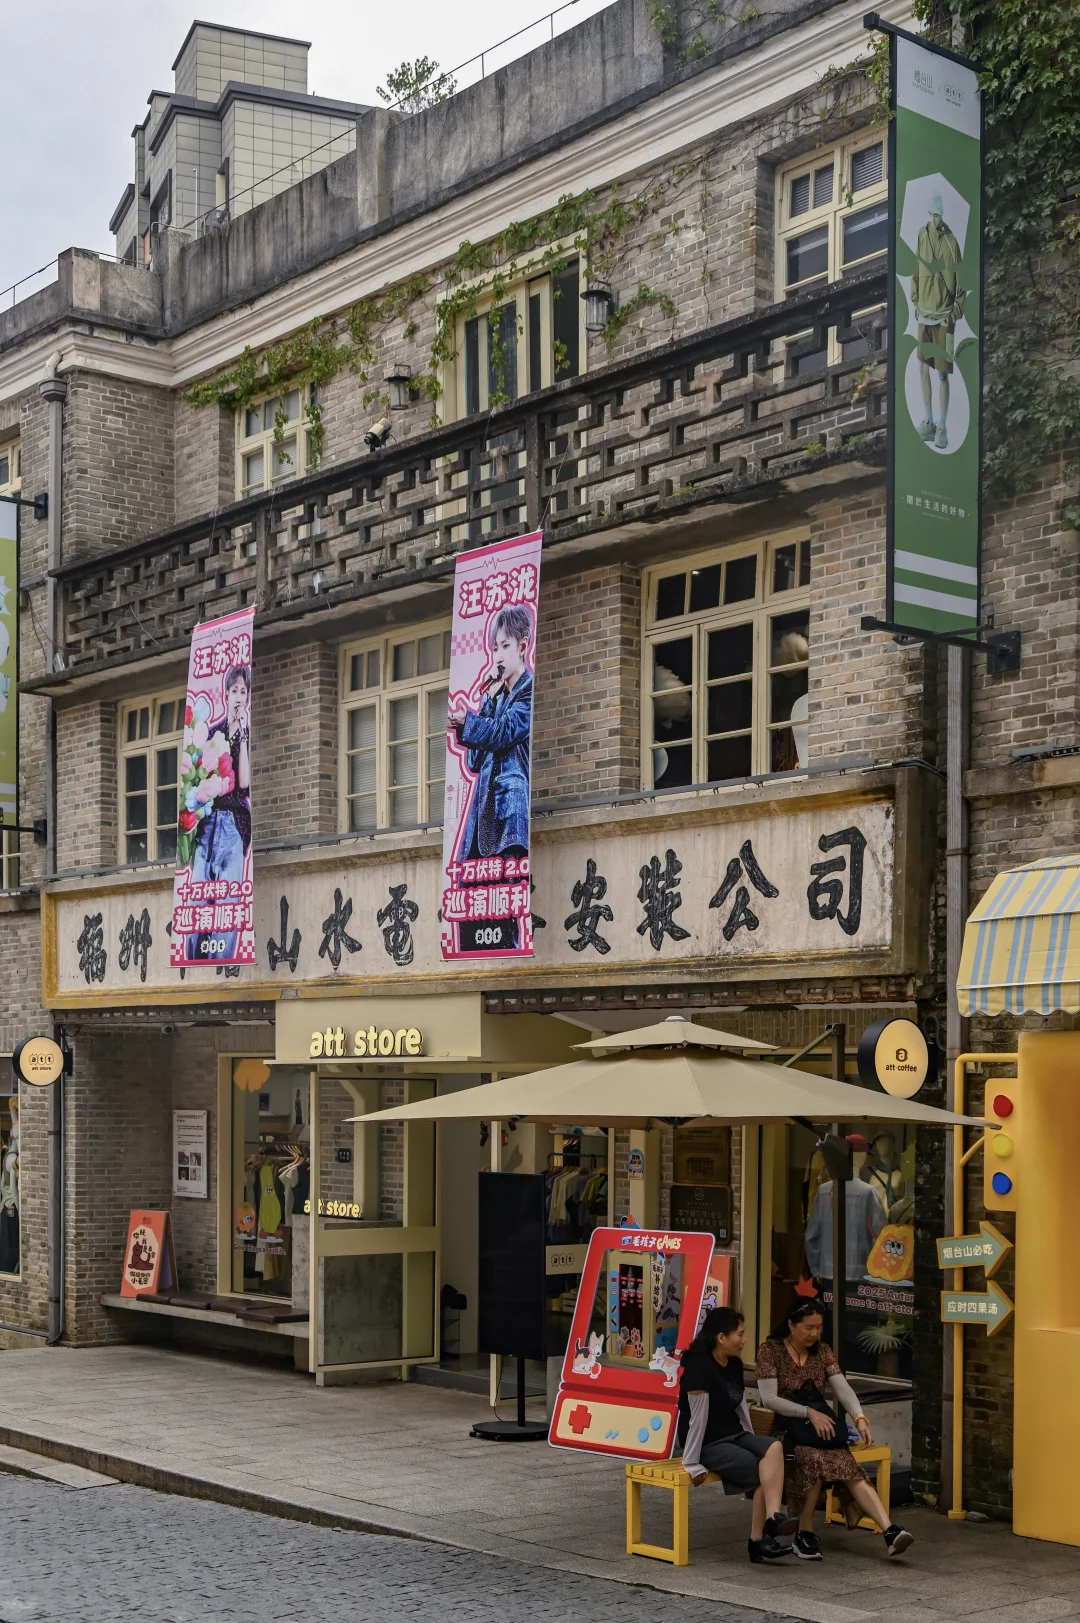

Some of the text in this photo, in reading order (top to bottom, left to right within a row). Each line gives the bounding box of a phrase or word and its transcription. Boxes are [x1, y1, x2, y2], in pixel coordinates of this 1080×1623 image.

[945, 86, 962, 99] att
[460, 564, 536, 617] 汪苏泷
[194, 633, 250, 679] 汪苏泷
[447, 859, 530, 881] 十万伏特 2.0
[179, 881, 252, 899] 十万伏特 2.0
[444, 885, 531, 918] 巡演顺利
[175, 904, 253, 931] 巡演顺利
[477, 929, 501, 943] att
[310, 1025, 422, 1056] att store
[31, 1055, 52, 1064] att
[304, 1199, 362, 1218] at store
[633, 1235, 682, 1250] 毛孩子 GAMES
[943, 1244, 993, 1259] 烟台山必吃
[552, 1255, 573, 1265] att
[858, 1285, 886, 1299] 2025
[866, 1299, 877, 1309] to
[948, 1301, 998, 1315] 应时四果汤
